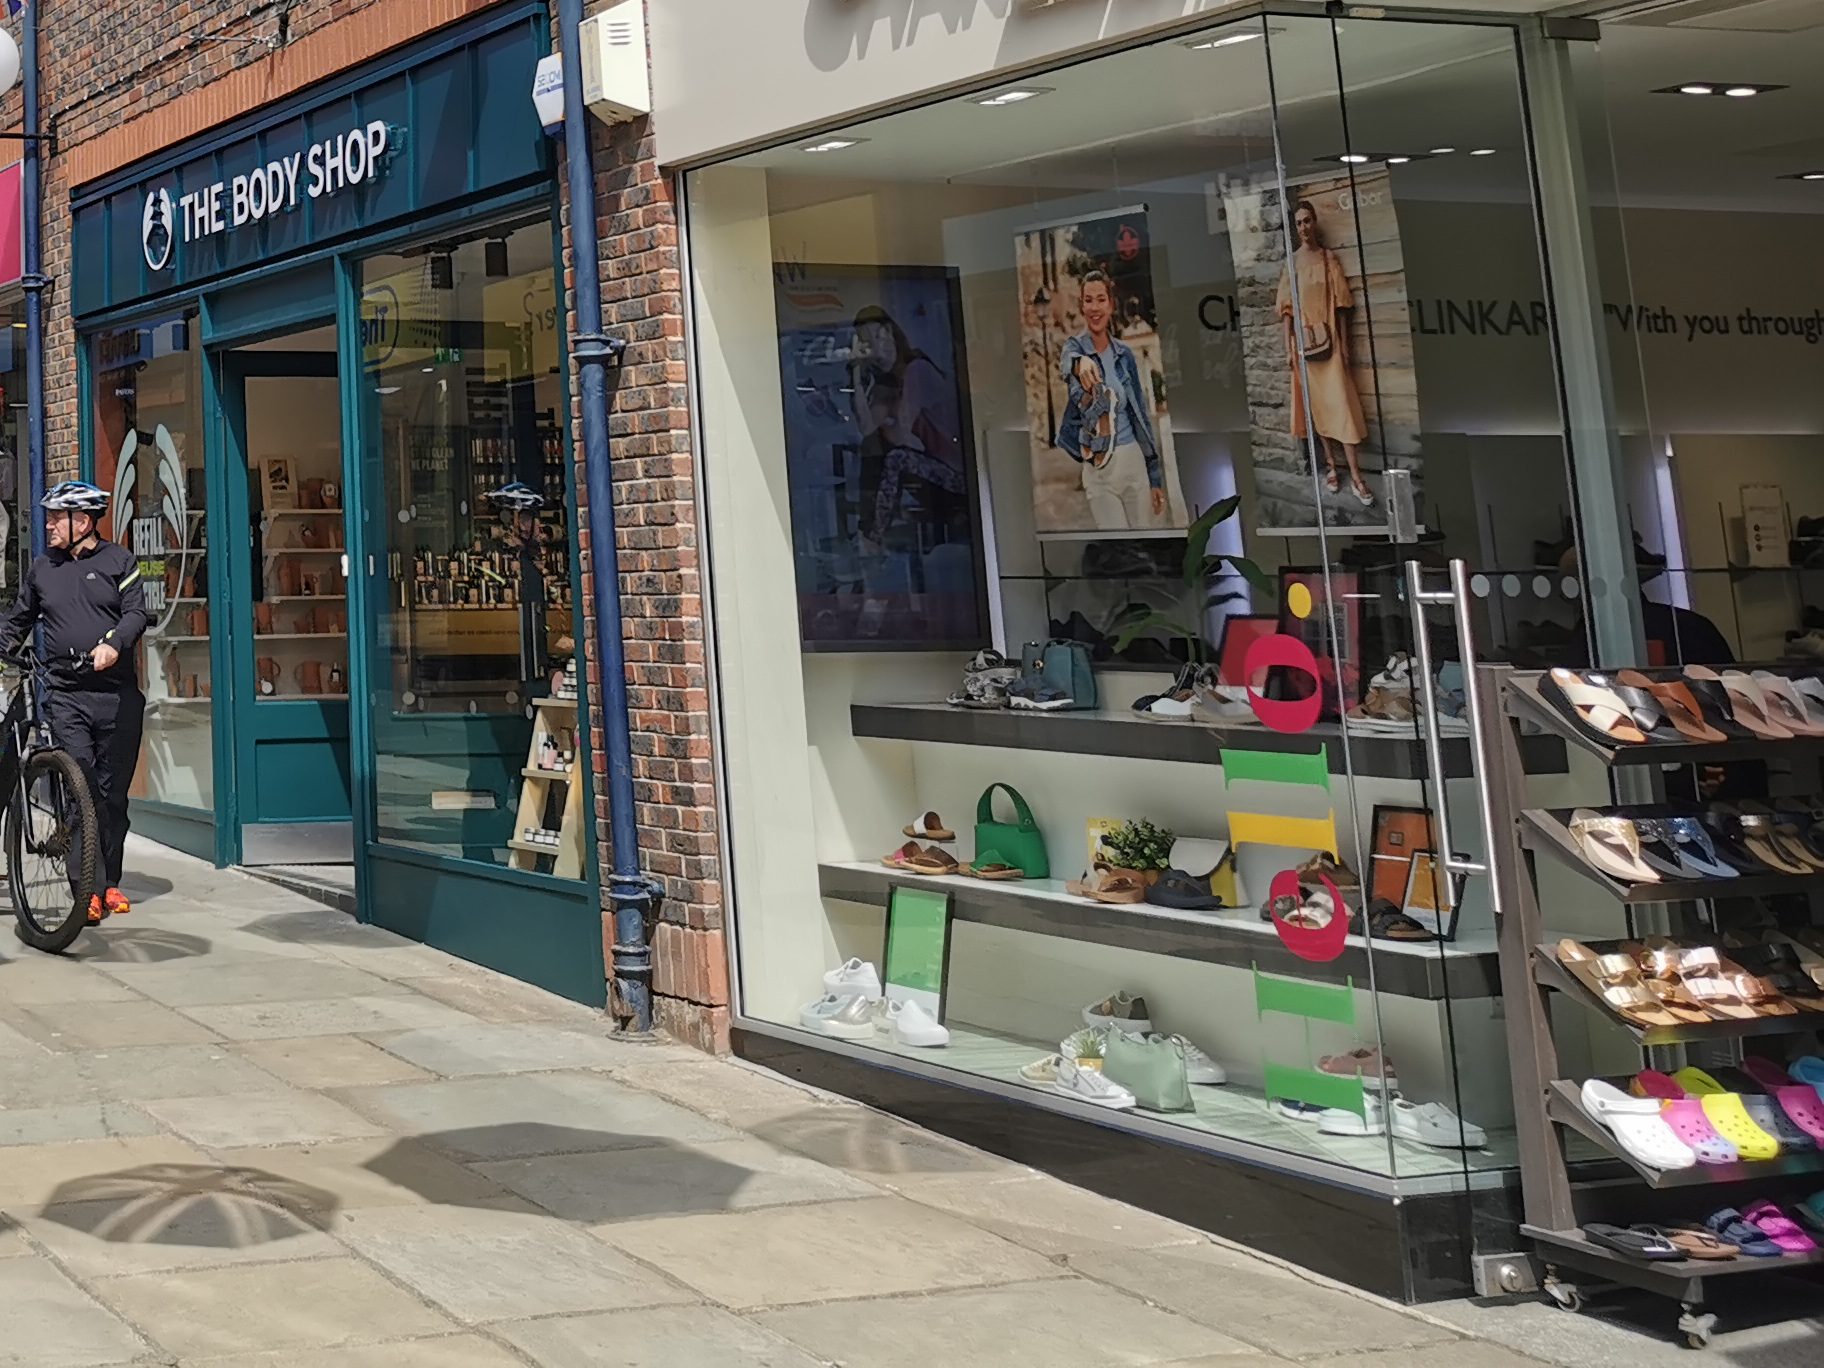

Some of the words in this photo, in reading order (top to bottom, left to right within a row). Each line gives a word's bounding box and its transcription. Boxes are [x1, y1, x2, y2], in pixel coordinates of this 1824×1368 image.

[180, 180, 225, 242] THE
[232, 151, 301, 226] BODY
[307, 120, 386, 198] SHOP
[1684, 315, 1730, 342] you
[133, 516, 165, 556] REFILL
[139, 560, 165, 576] EUSE
